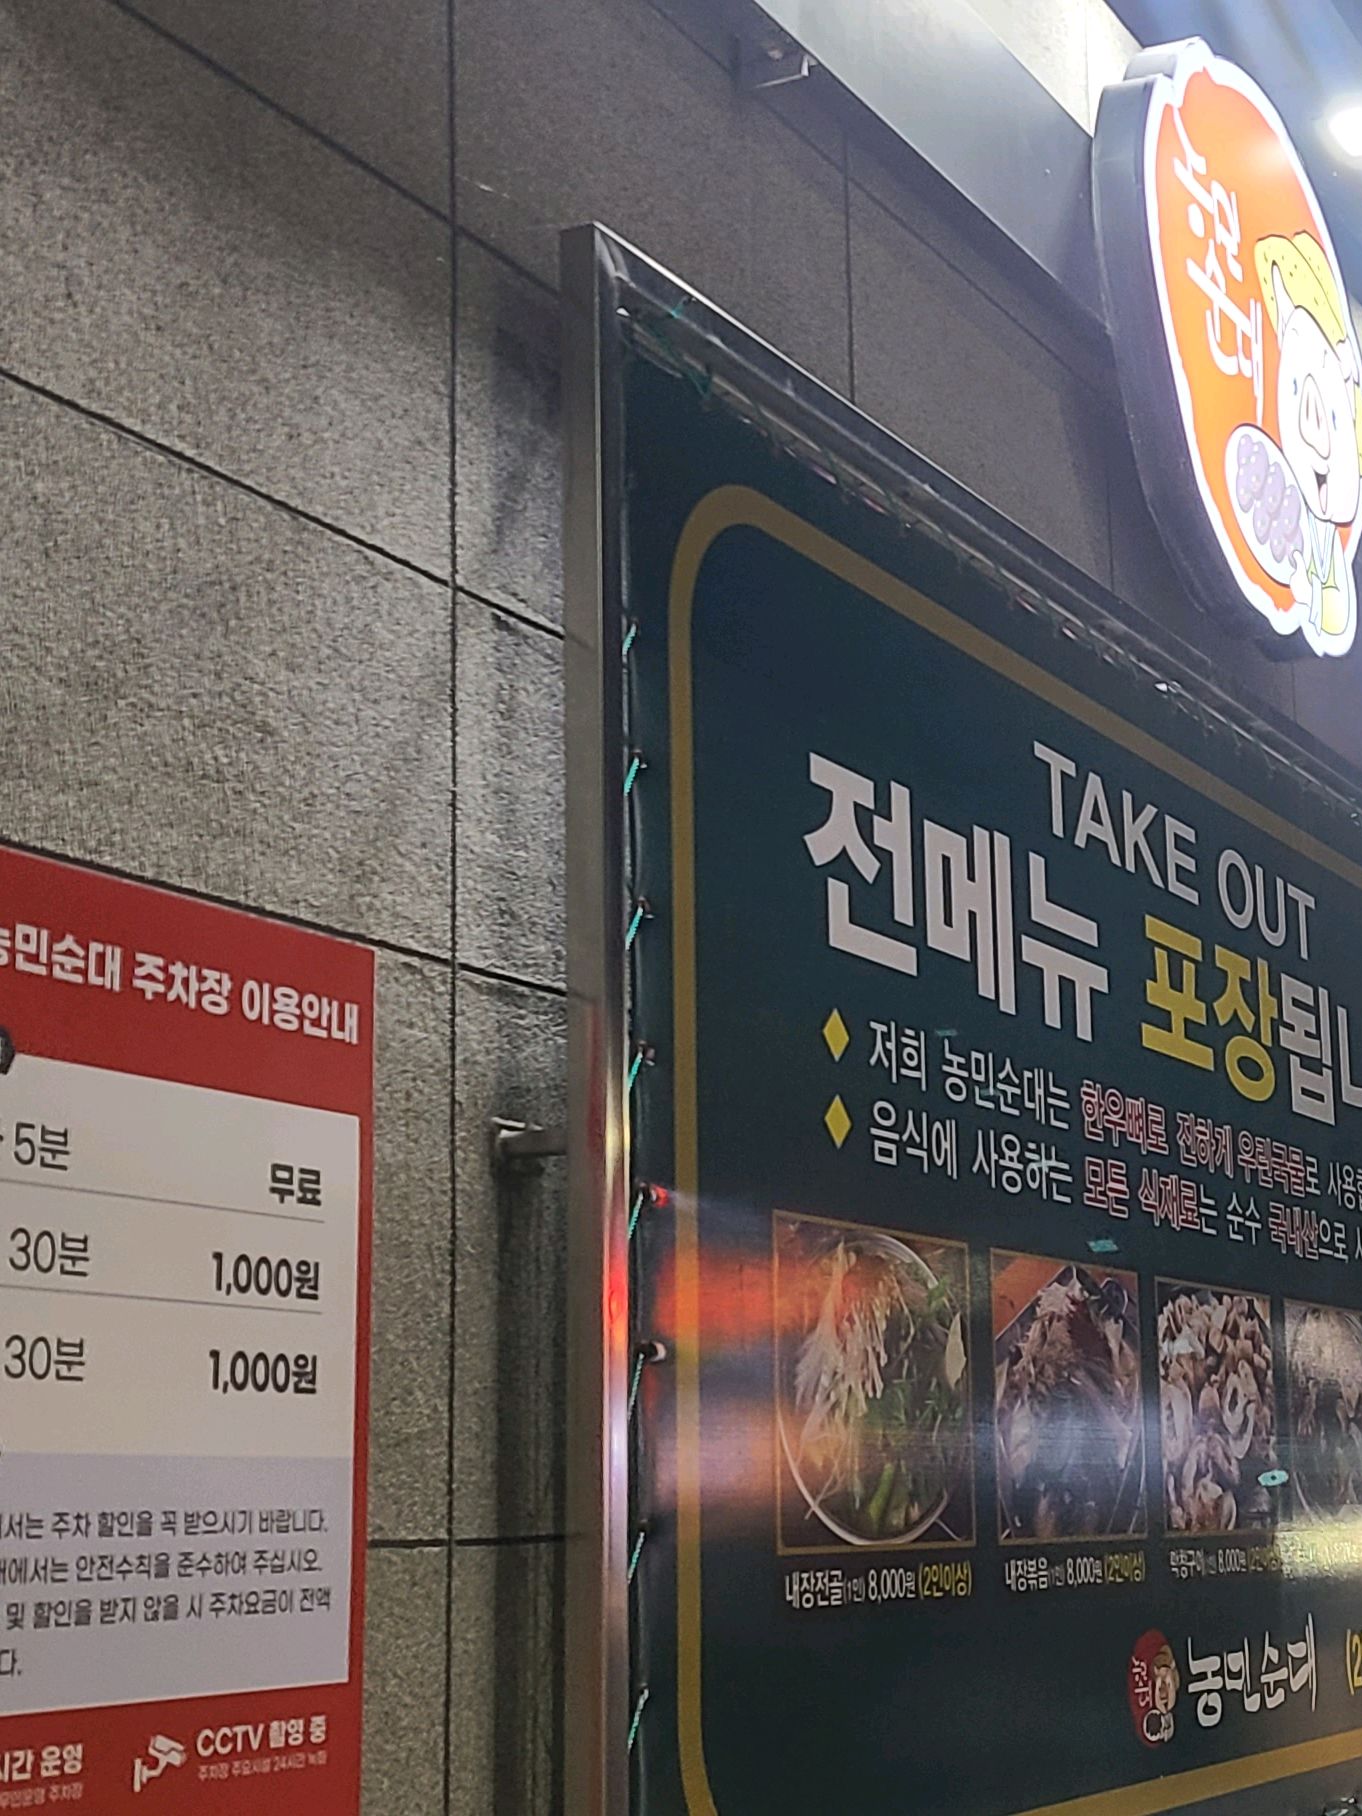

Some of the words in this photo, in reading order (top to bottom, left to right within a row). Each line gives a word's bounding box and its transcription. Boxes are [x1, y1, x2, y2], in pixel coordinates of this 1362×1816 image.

[1032, 740, 1200, 907] TAKE
[1216, 848, 1316, 961] OUT
[804, 750, 1110, 1044] 전메뉴
[133, 951, 233, 1017] 주차장
[242, 979, 360, 1046] 이용안내
[869, 1020, 928, 1093] 저희
[941, 1038, 1071, 1131] 농민순대는
[1080, 1078, 1170, 1156] 한우뼈로
[14, 1121, 71, 1172] 5분
[269, 1163, 322, 1207] 무료
[870, 1100, 958, 1181] 음식에
[971, 1128, 1073, 1205] 사용하는
[1082, 1155, 1130, 1220] 모든
[1138, 1167, 1218, 1236] 식재료는
[1226, 1191, 1262, 1246] 순수
[1268, 1201, 1349, 1264] 국내산으로
[9, 1227, 90, 1278] 30분
[212, 1250, 320, 1301] 1,000원
[4, 1334, 86, 1382] 30분
[209, 1349, 318, 1395] 1,000원
[0, 1512, 44, 1540] 서는
[52, 1512, 91, 1540] 주차
[97, 1510, 153, 1538] 할인을
[161, 1510, 176, 1537] 꼭
[184, 1510, 252, 1535] 받으시기
[259, 1509, 328, 1535] 바랍니다.
[76, 1552, 170, 1582] 안전수칙을
[178, 1551, 246, 1578] 준수하여
[254, 1548, 323, 1576] 주십시오.
[868, 1567, 916, 1605] 8,000원
[918, 1560, 972, 1600] (2인이상)
[1066, 1556, 1103, 1589] 8,000원
[6, 1602, 25, 1630] 및
[33, 1598, 92, 1629] 할인을
[100, 1596, 137, 1625] 받지
[144, 1593, 179, 1622] 않을
[186, 1592, 203, 1620] 시
[210, 1589, 294, 1619] 주차요금이
[300, 1586, 331, 1613] 전액
[1187, 1611, 1318, 1727] 농민순대
[40, 1743, 83, 1778] 운영
[196, 1723, 265, 1758] CCTV
